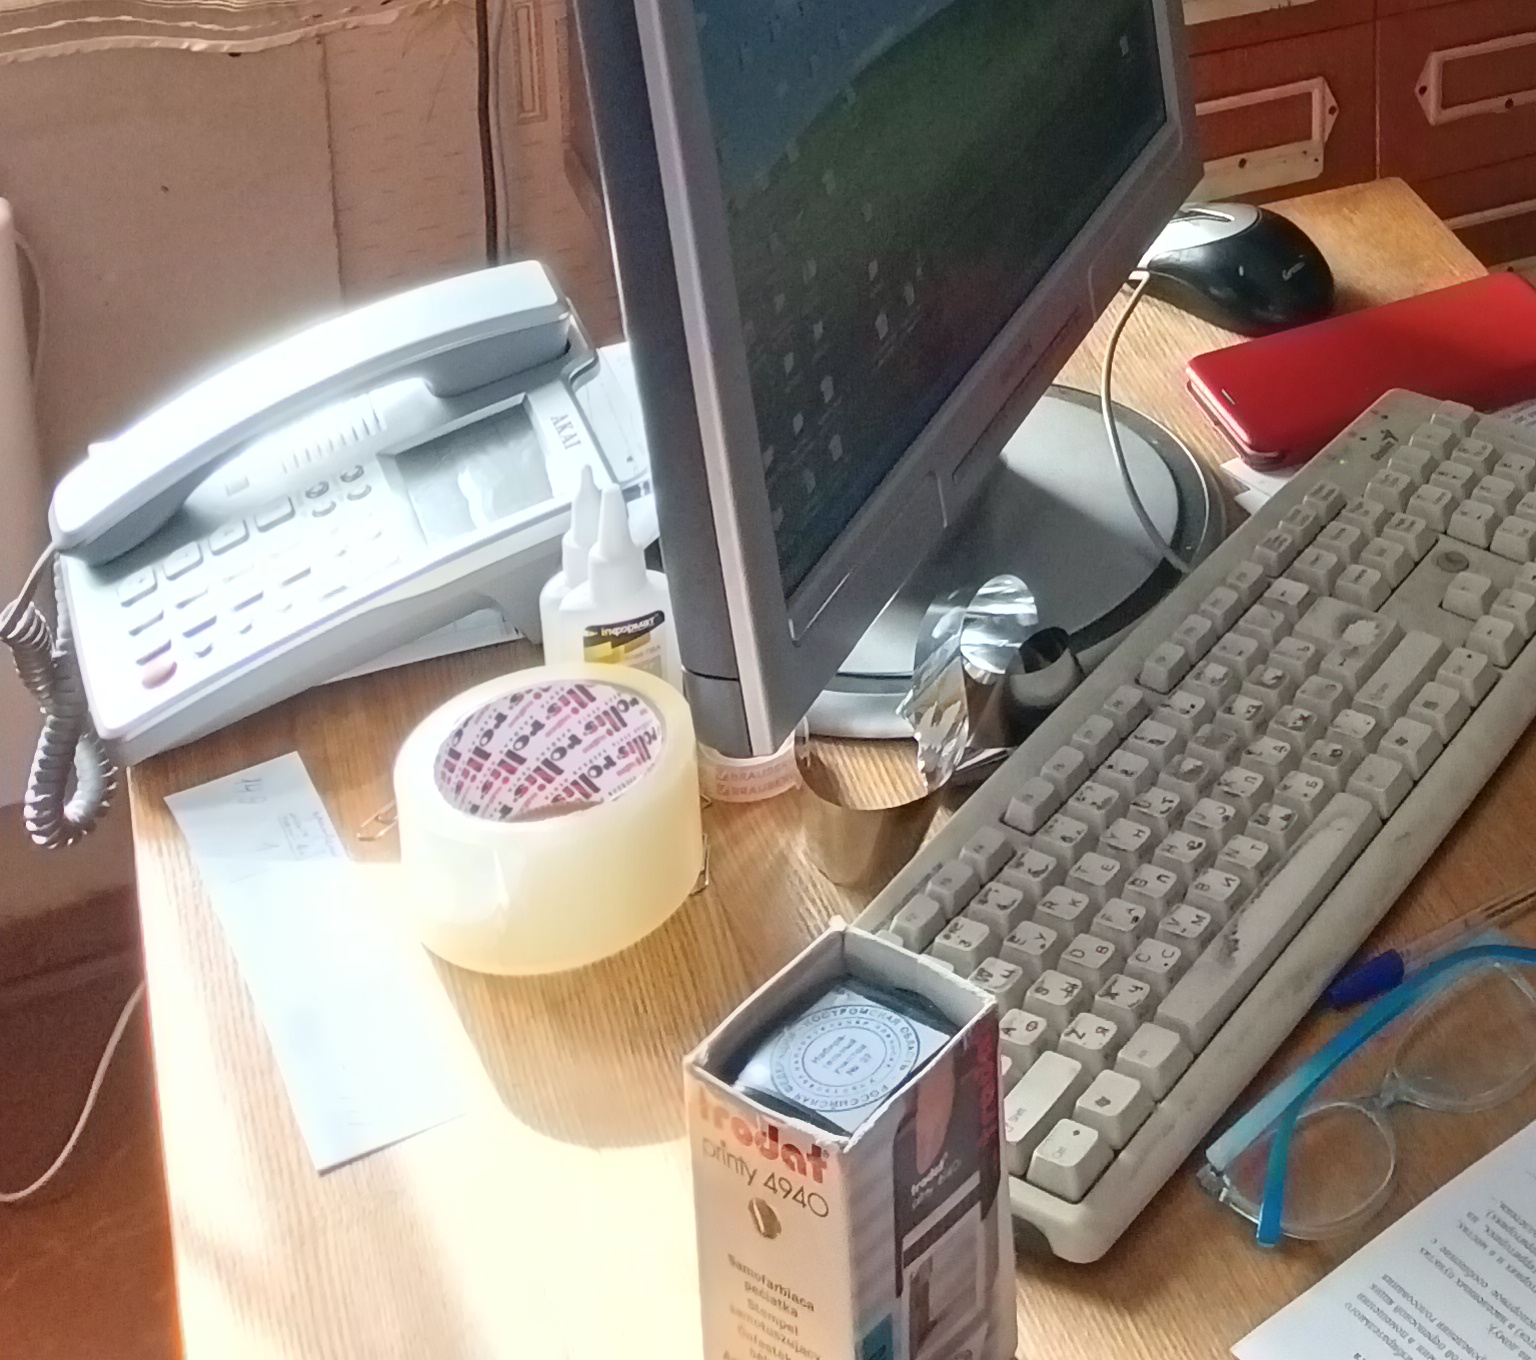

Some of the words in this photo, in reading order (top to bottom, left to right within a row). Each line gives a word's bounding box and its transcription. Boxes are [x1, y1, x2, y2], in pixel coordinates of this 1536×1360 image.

[550, 412, 583, 451] AKAI
[699, 1087, 823, 1184] trodat
[702, 1137, 757, 1186] printy
[763, 1172, 829, 1218] 4940
